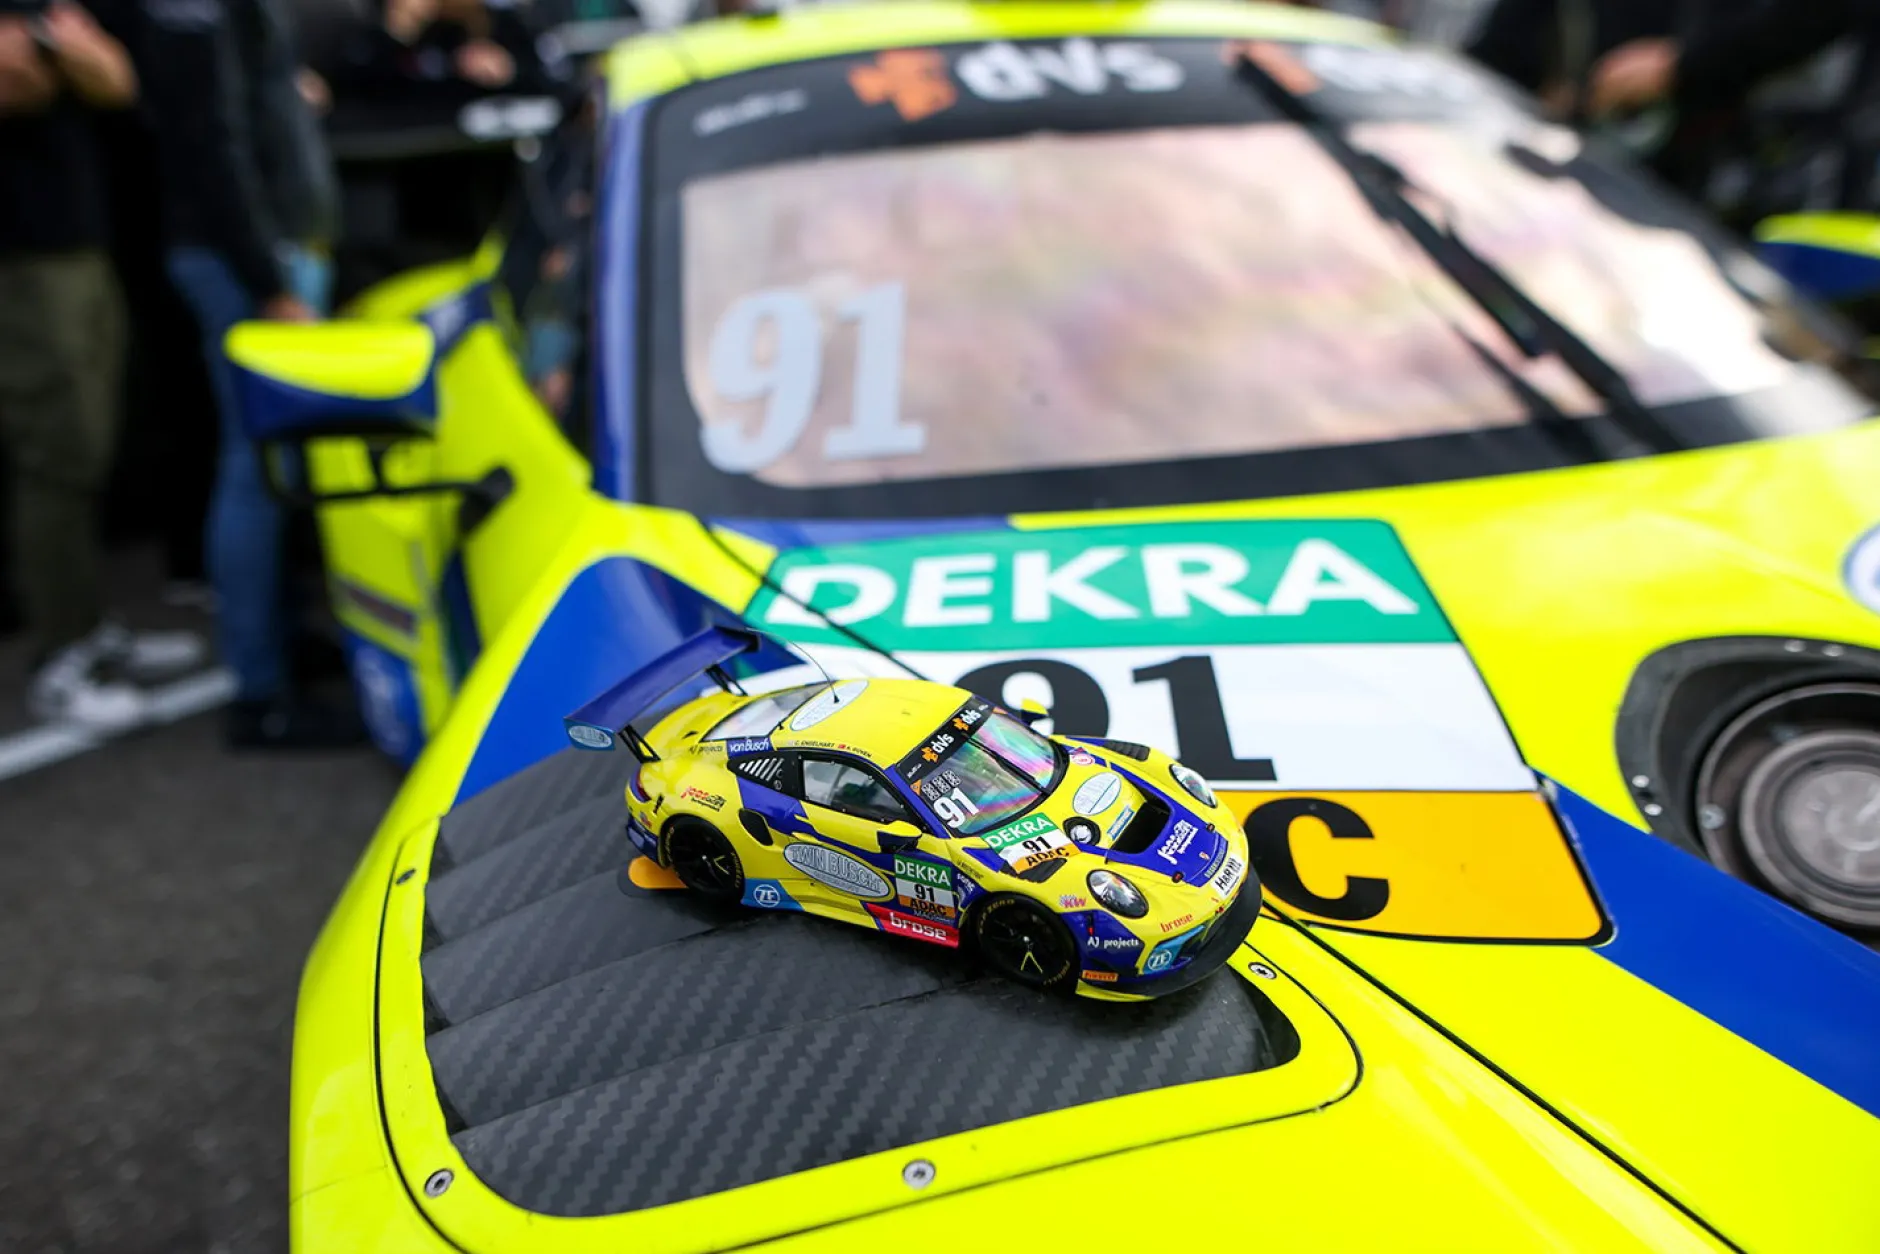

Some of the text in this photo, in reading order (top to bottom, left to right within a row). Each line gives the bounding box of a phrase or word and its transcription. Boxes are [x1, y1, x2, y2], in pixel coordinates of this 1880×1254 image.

[700, 281, 927, 474] 91
[764, 538, 1418, 627] DEKRA
[931, 733, 955, 754] dvs
[933, 788, 980, 828] 91
[986, 817, 1053, 848] DEKRA
[1022, 836, 1052, 853] 91
[791, 844, 825, 869] TWIN
[827, 850, 884, 893] BUSCH
[895, 858, 951, 887] DEKRA
[910, 899, 947, 916] ADAC
[914, 883, 935, 903] 91
[889, 912, 947, 941] brose
[1160, 913, 1194, 933] brose
[1087, 936, 1139, 949] AJ projects
